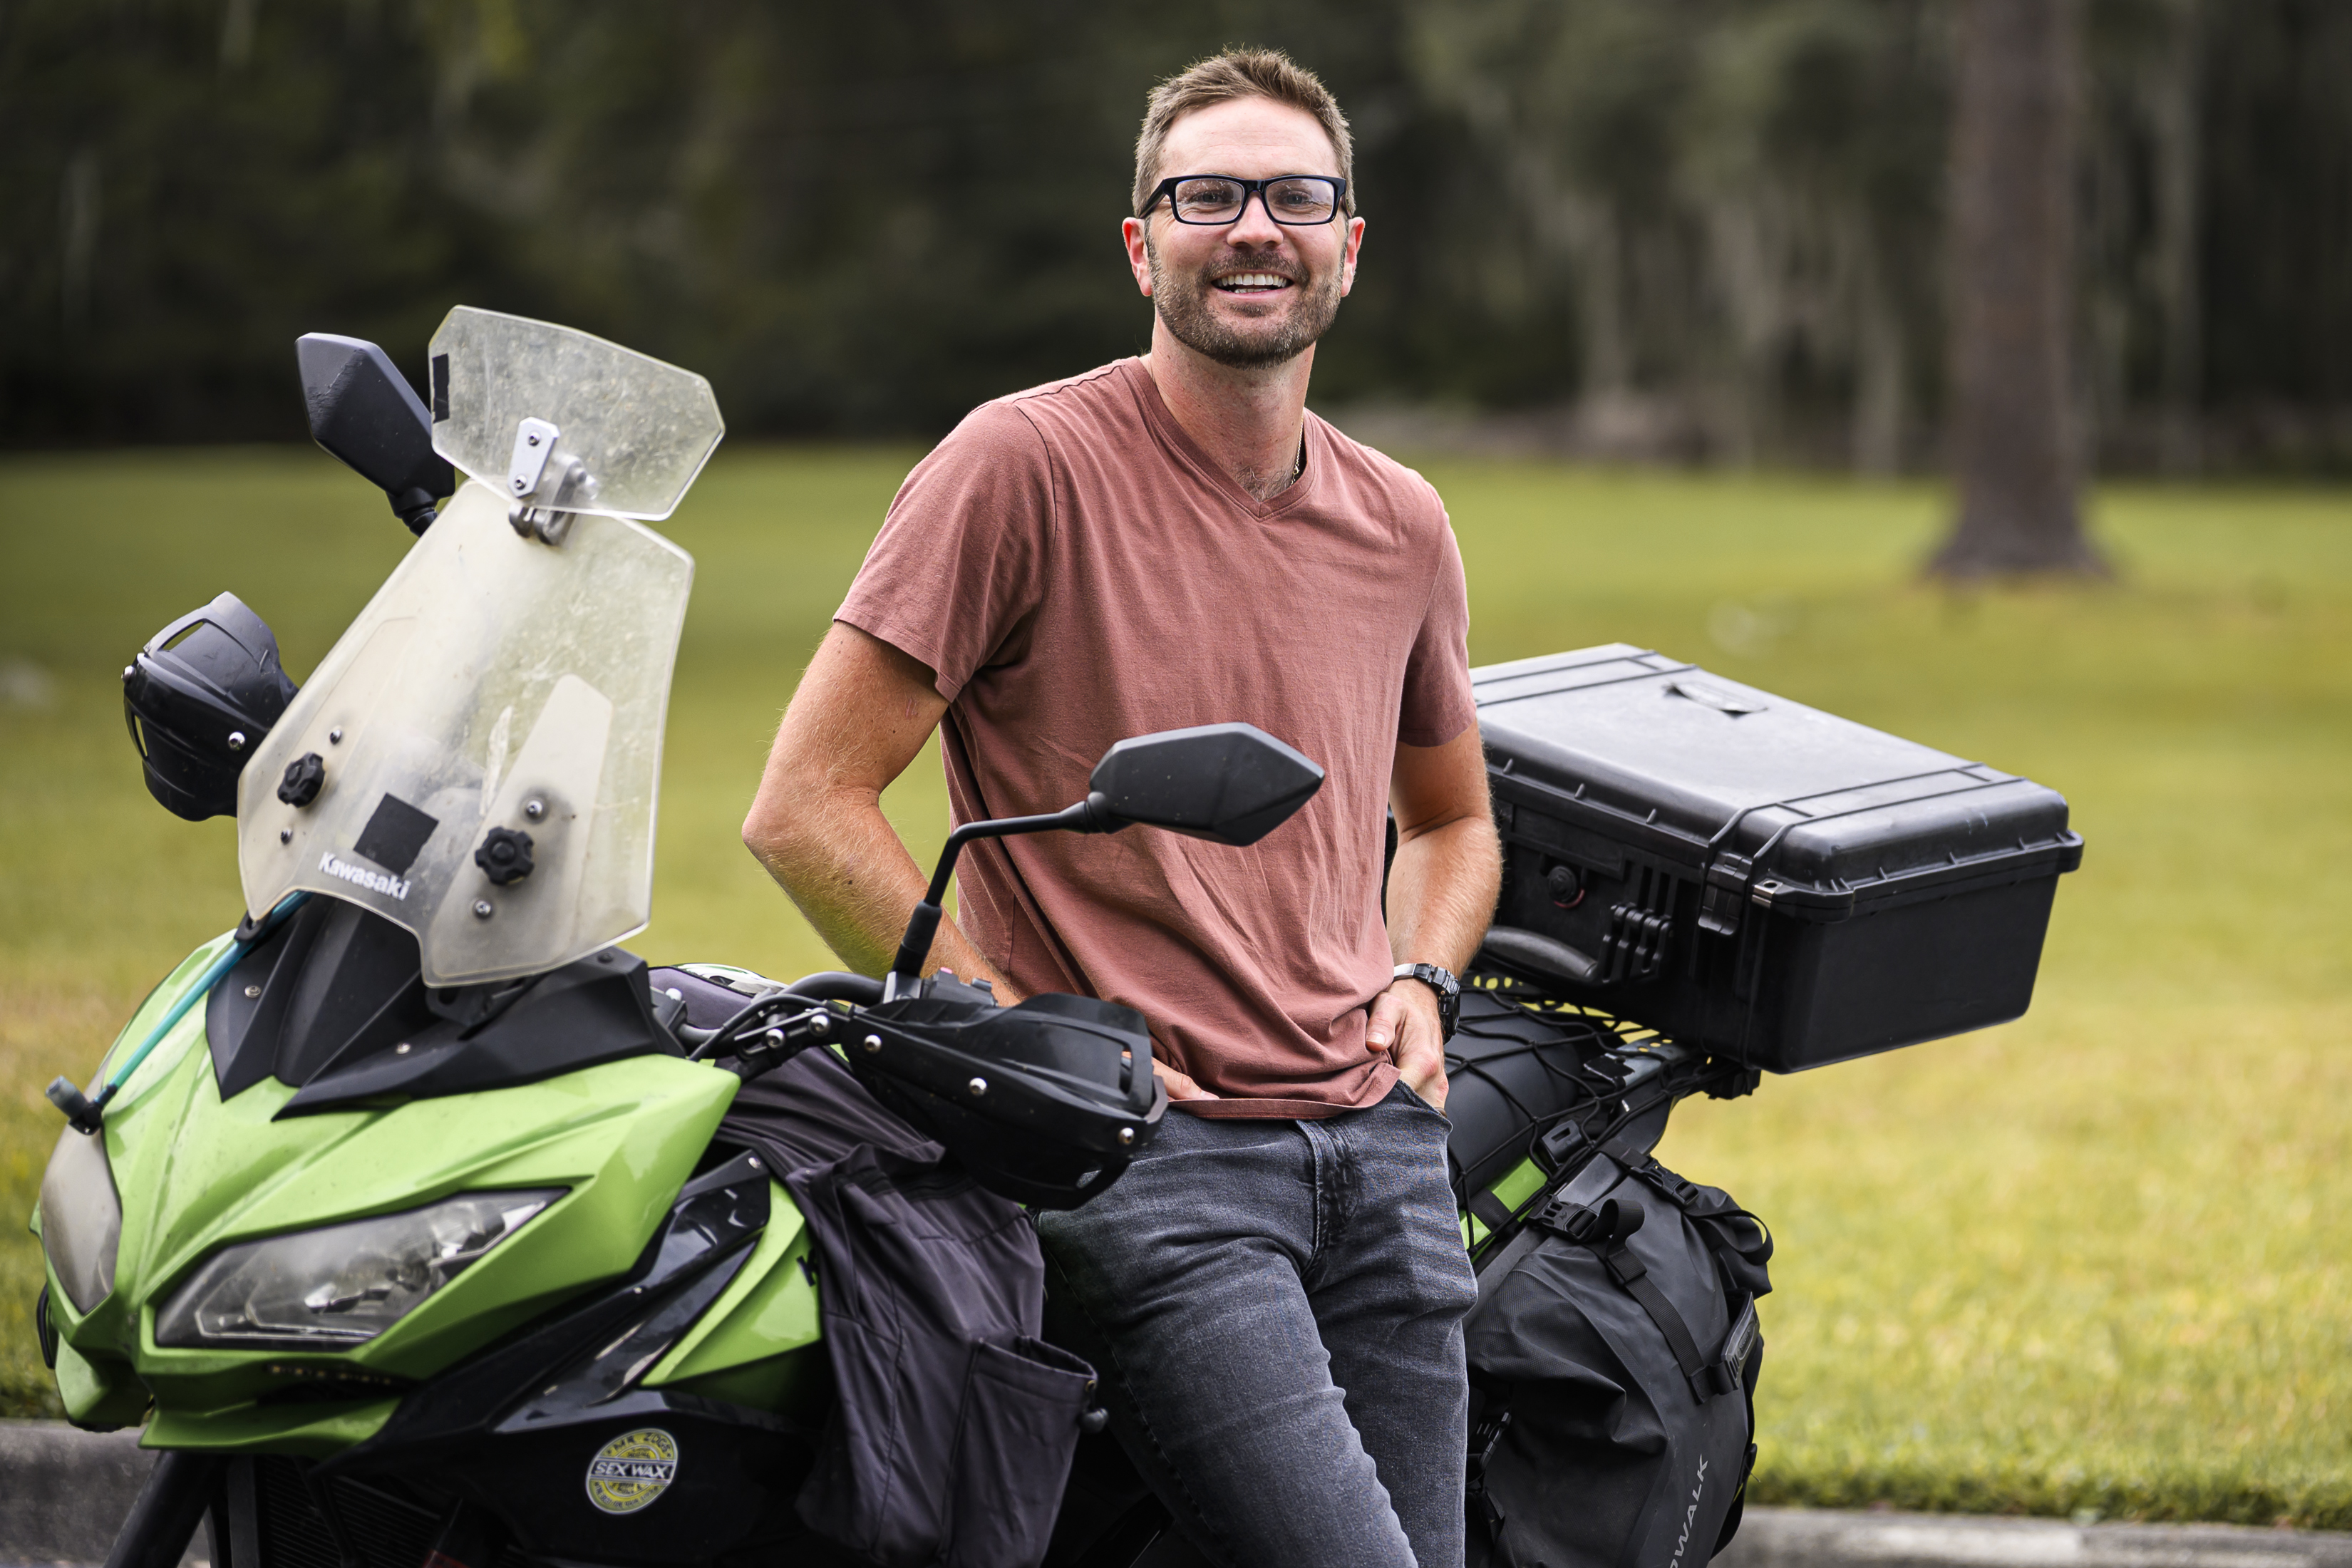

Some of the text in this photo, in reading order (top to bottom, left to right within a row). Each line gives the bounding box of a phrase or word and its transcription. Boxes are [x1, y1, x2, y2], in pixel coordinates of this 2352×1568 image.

[318, 851, 412, 901] Kawasaki
[594, 1462, 669, 1479] SEX WAX
